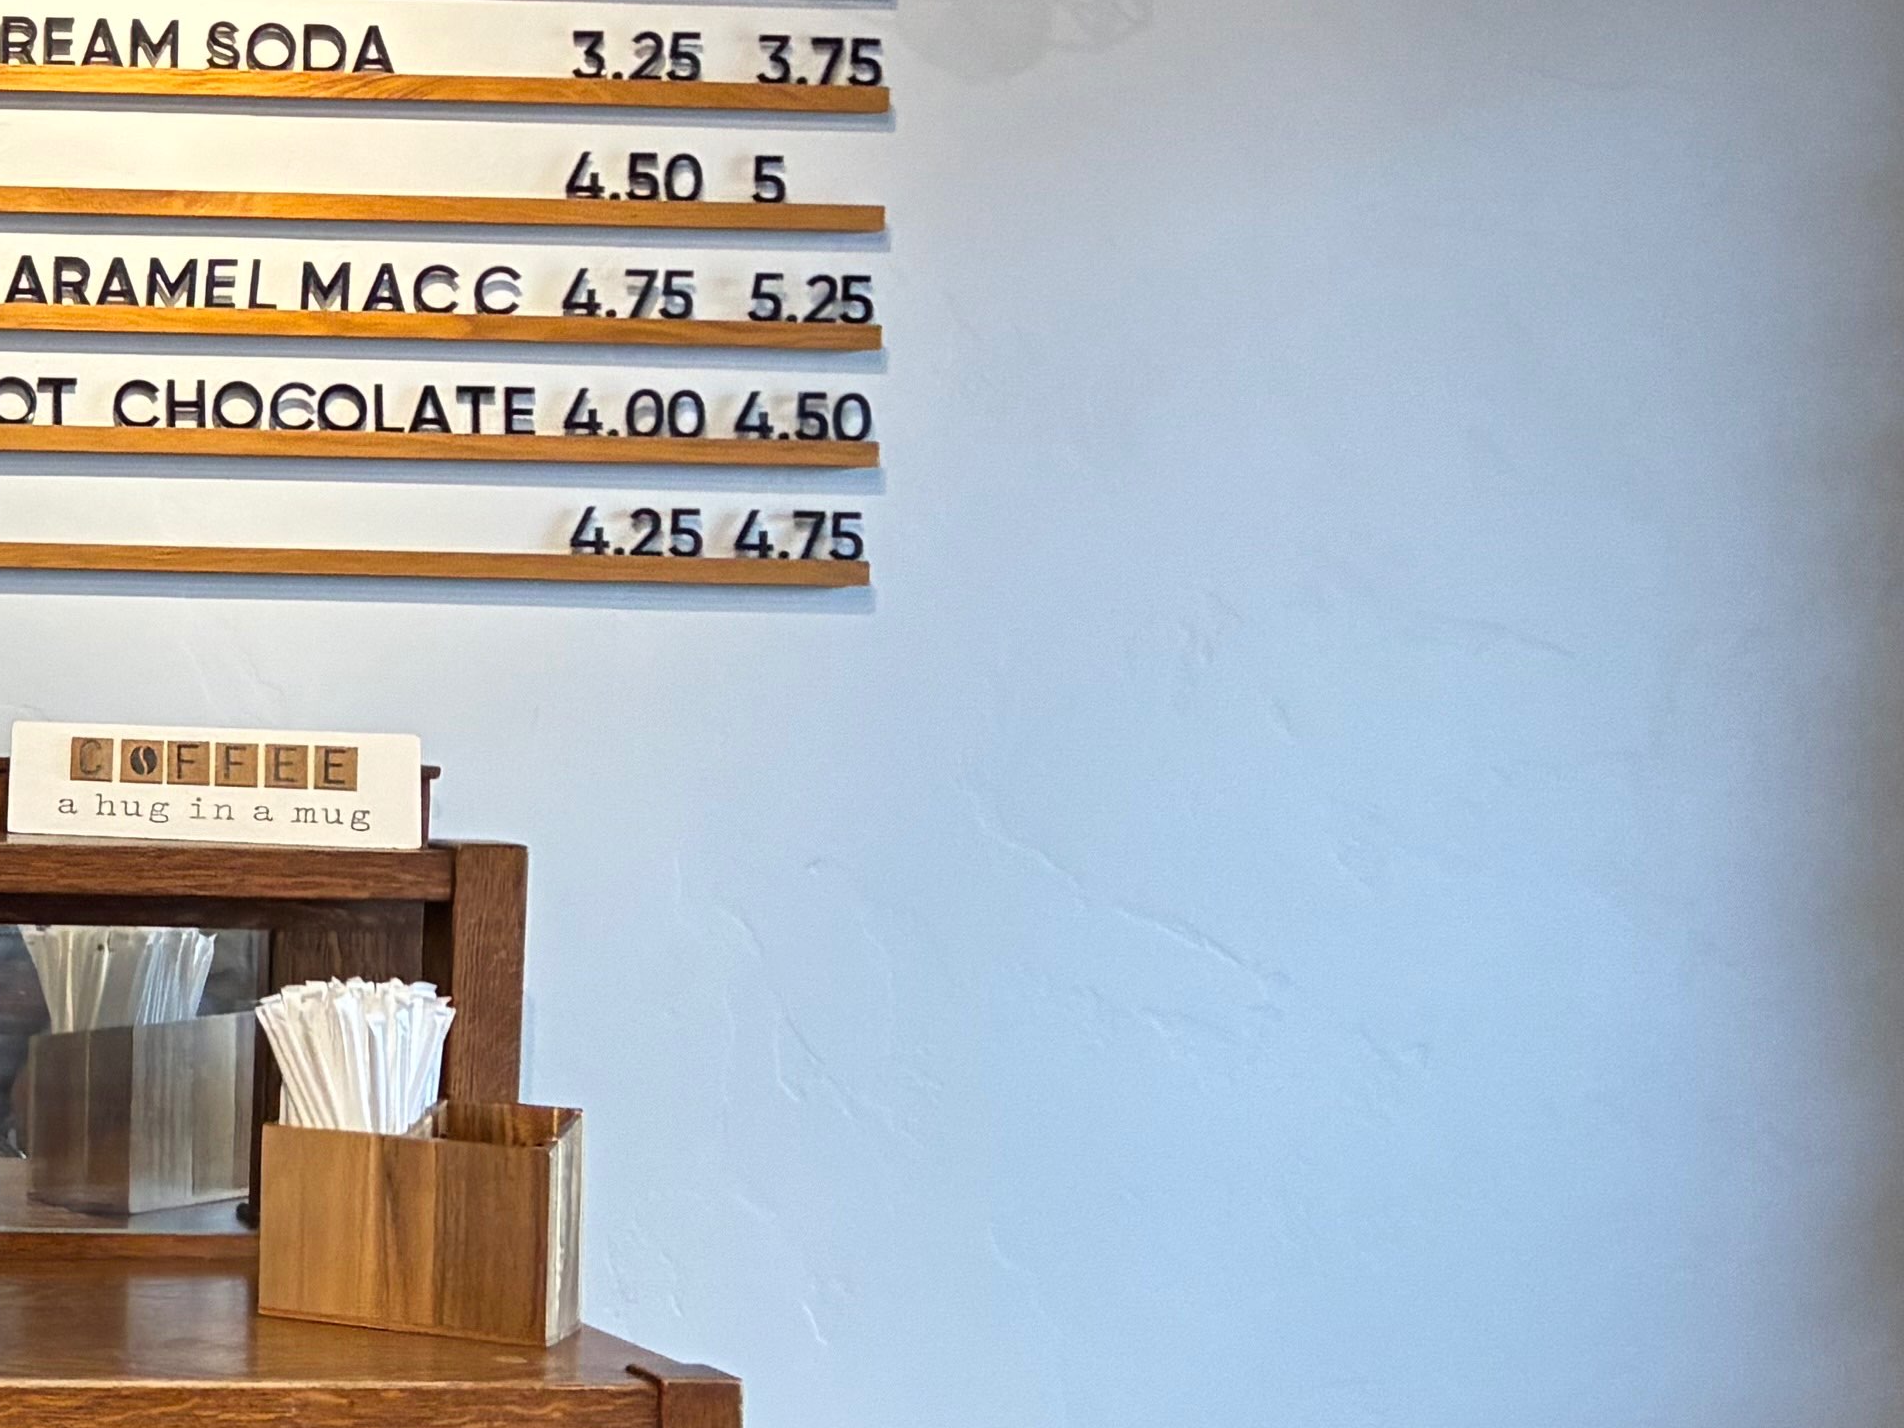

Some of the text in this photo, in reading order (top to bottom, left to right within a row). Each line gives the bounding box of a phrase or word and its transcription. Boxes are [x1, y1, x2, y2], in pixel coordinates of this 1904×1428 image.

[206, 21, 395, 74] SODA
[571, 30, 703, 81] 3.25
[757, 35, 883, 86] 3.75
[565, 151, 704, 202] 4.50
[752, 155, 787, 203] 5
[300, 261, 523, 315] MACC
[562, 267, 694, 319] 4.75
[748, 272, 874, 323] 5.25
[112, 378, 536, 435] CHOCOLATE
[563, 387, 707, 438] 4.00
[735, 390, 872, 441] 4.50
[569, 506, 703, 557] 4.25
[735, 510, 864, 561] 4.75
[57, 792, 372, 832] a hug in a mug
